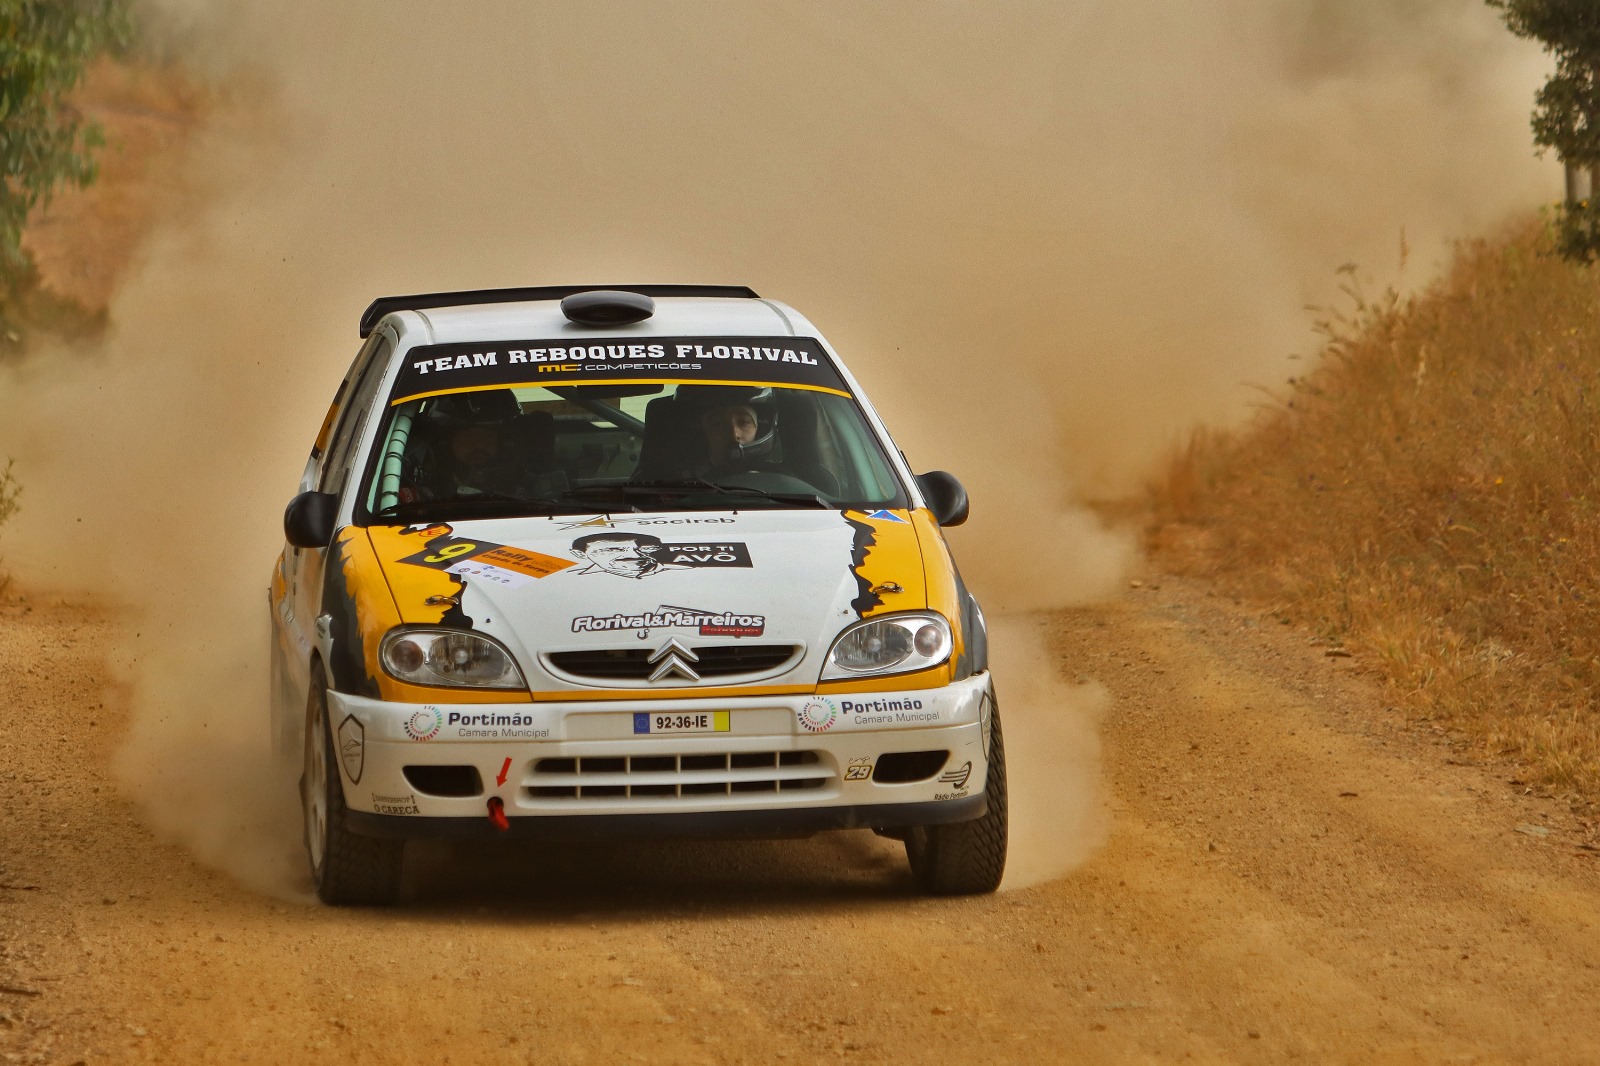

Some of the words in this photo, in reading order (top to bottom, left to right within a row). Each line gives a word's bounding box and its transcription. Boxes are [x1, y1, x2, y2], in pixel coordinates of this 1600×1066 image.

[413, 352, 498, 375] TEAM
[508, 344, 666, 364] REBOQUES
[676, 344, 819, 366] FLORIVAL
[637, 517, 736, 526] socireb
[423, 542, 477, 564] 9
[491, 549, 533, 562] Rally
[672, 552, 737, 563] AVÔ
[841, 697, 923, 715] Portimão
[448, 712, 533, 726] Portimão
[656, 715, 708, 729] 92-36-IE
[854, 715, 893, 725] Camara
[895, 711, 940, 723] Municipal
[458, 728, 498, 738] Camara
[501, 727, 549, 739] Municipal
[844, 765, 872, 781] 29
[381, 805, 421, 815] CARECA
